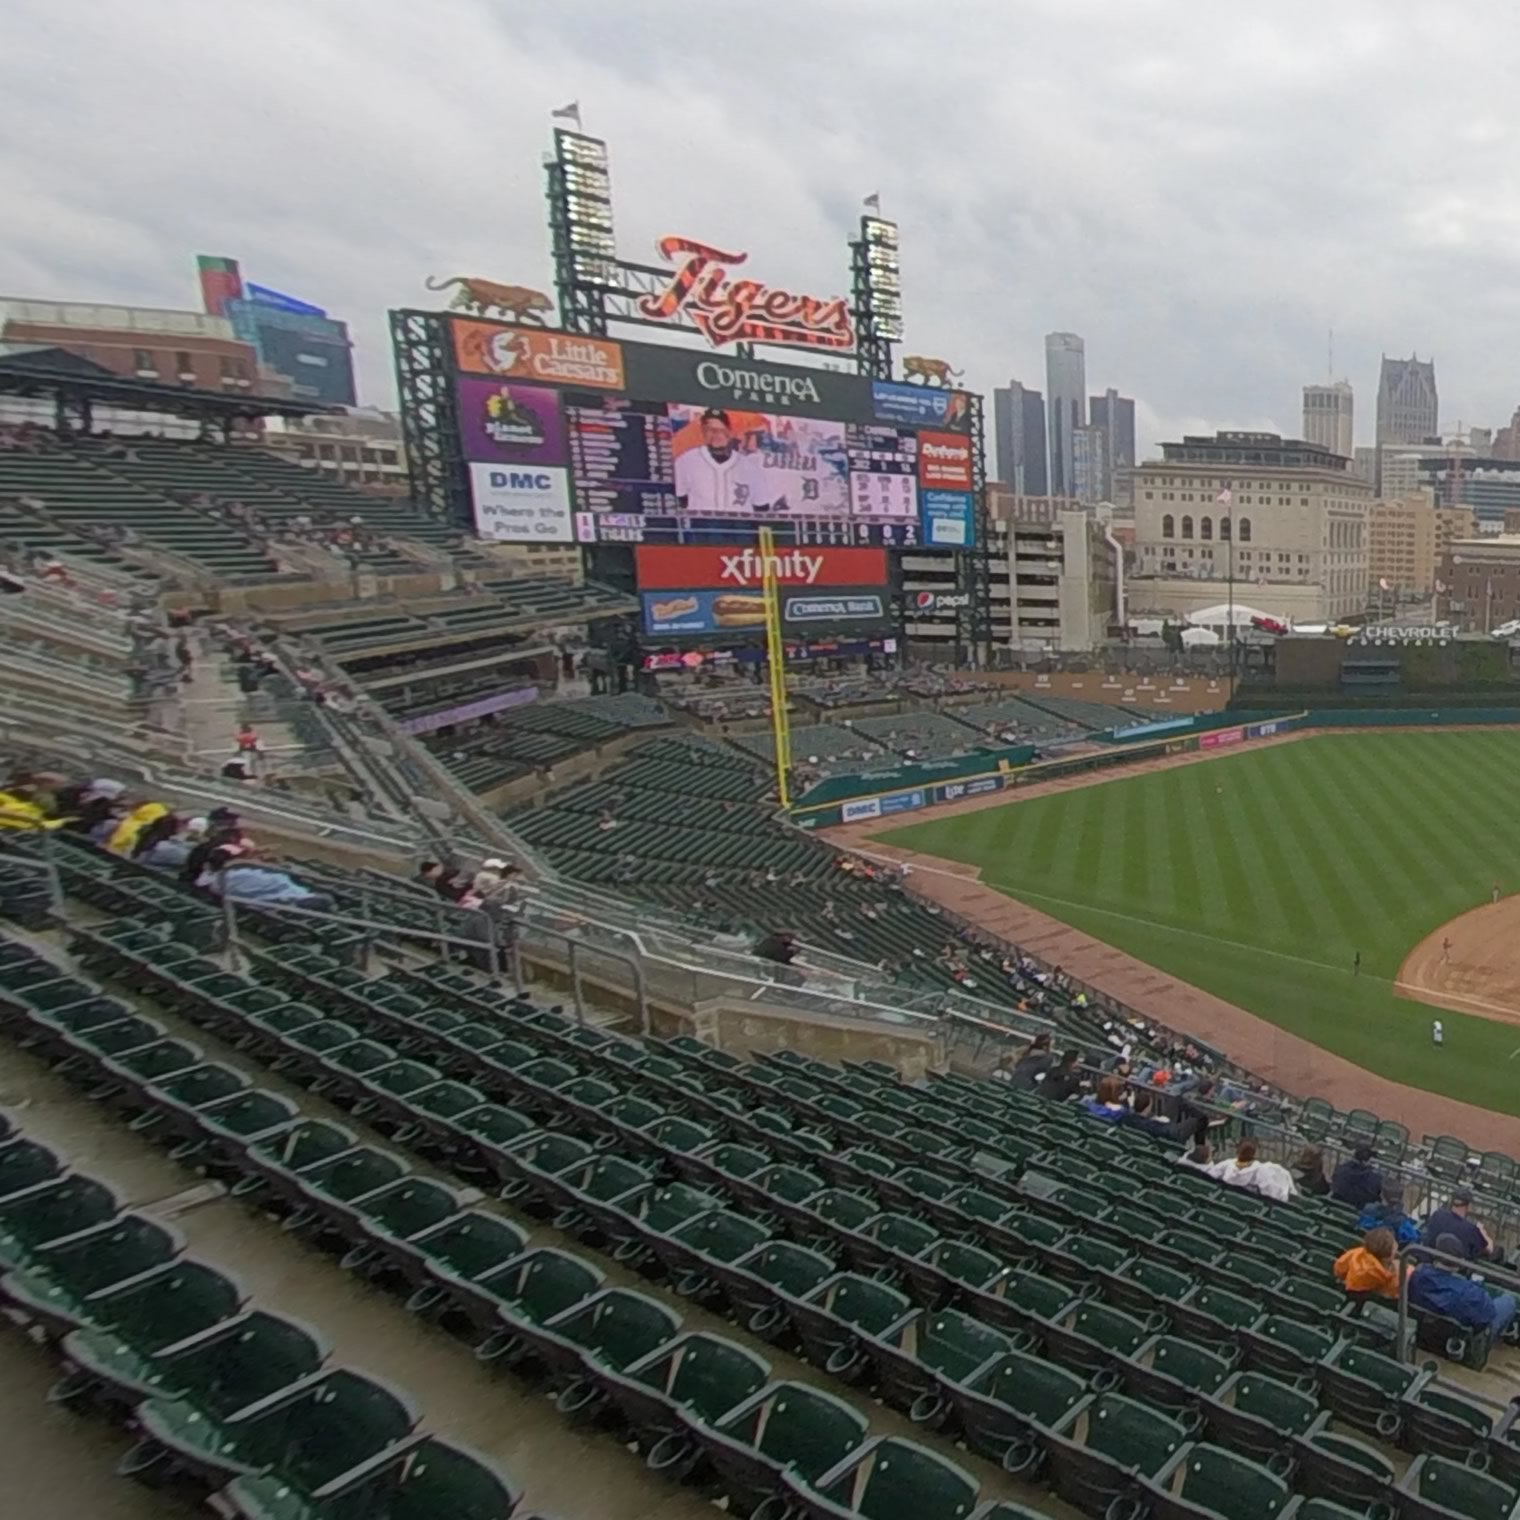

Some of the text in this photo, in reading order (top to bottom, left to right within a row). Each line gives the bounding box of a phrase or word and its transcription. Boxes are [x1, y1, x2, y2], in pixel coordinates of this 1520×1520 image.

[638, 233, 854, 336] Tigers
[548, 338, 607, 365] Little
[533, 353, 618, 383] Caesars
[489, 472, 552, 490] DMC
[482, 504, 565, 518] Where the
[721, 549, 824, 585] xfinity
[1366, 624, 1460, 639] CHEVROLET
[847, 802, 876, 817] DMC
